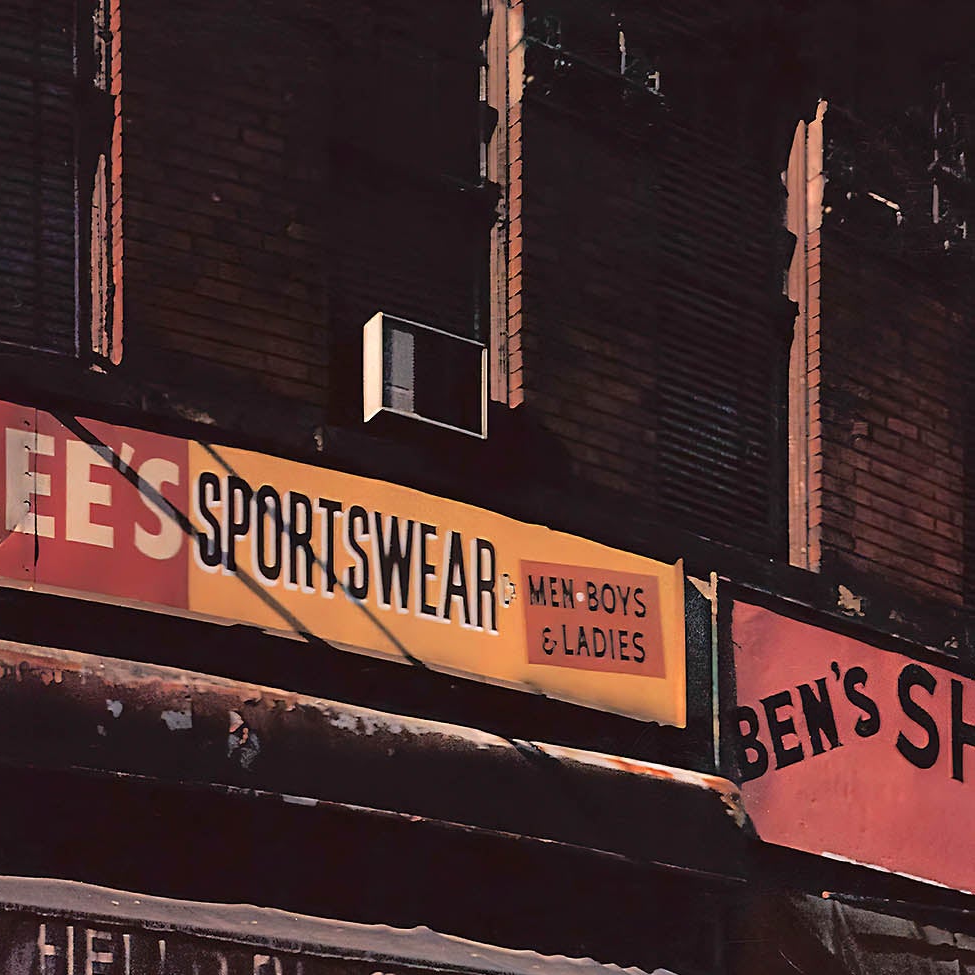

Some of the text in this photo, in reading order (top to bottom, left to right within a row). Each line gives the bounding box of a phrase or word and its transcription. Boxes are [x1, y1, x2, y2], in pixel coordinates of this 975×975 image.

[194, 470, 499, 633] SPORTSWEAR
[562, 624, 646, 663] LADIES
[734, 660, 881, 784] BEN'S
